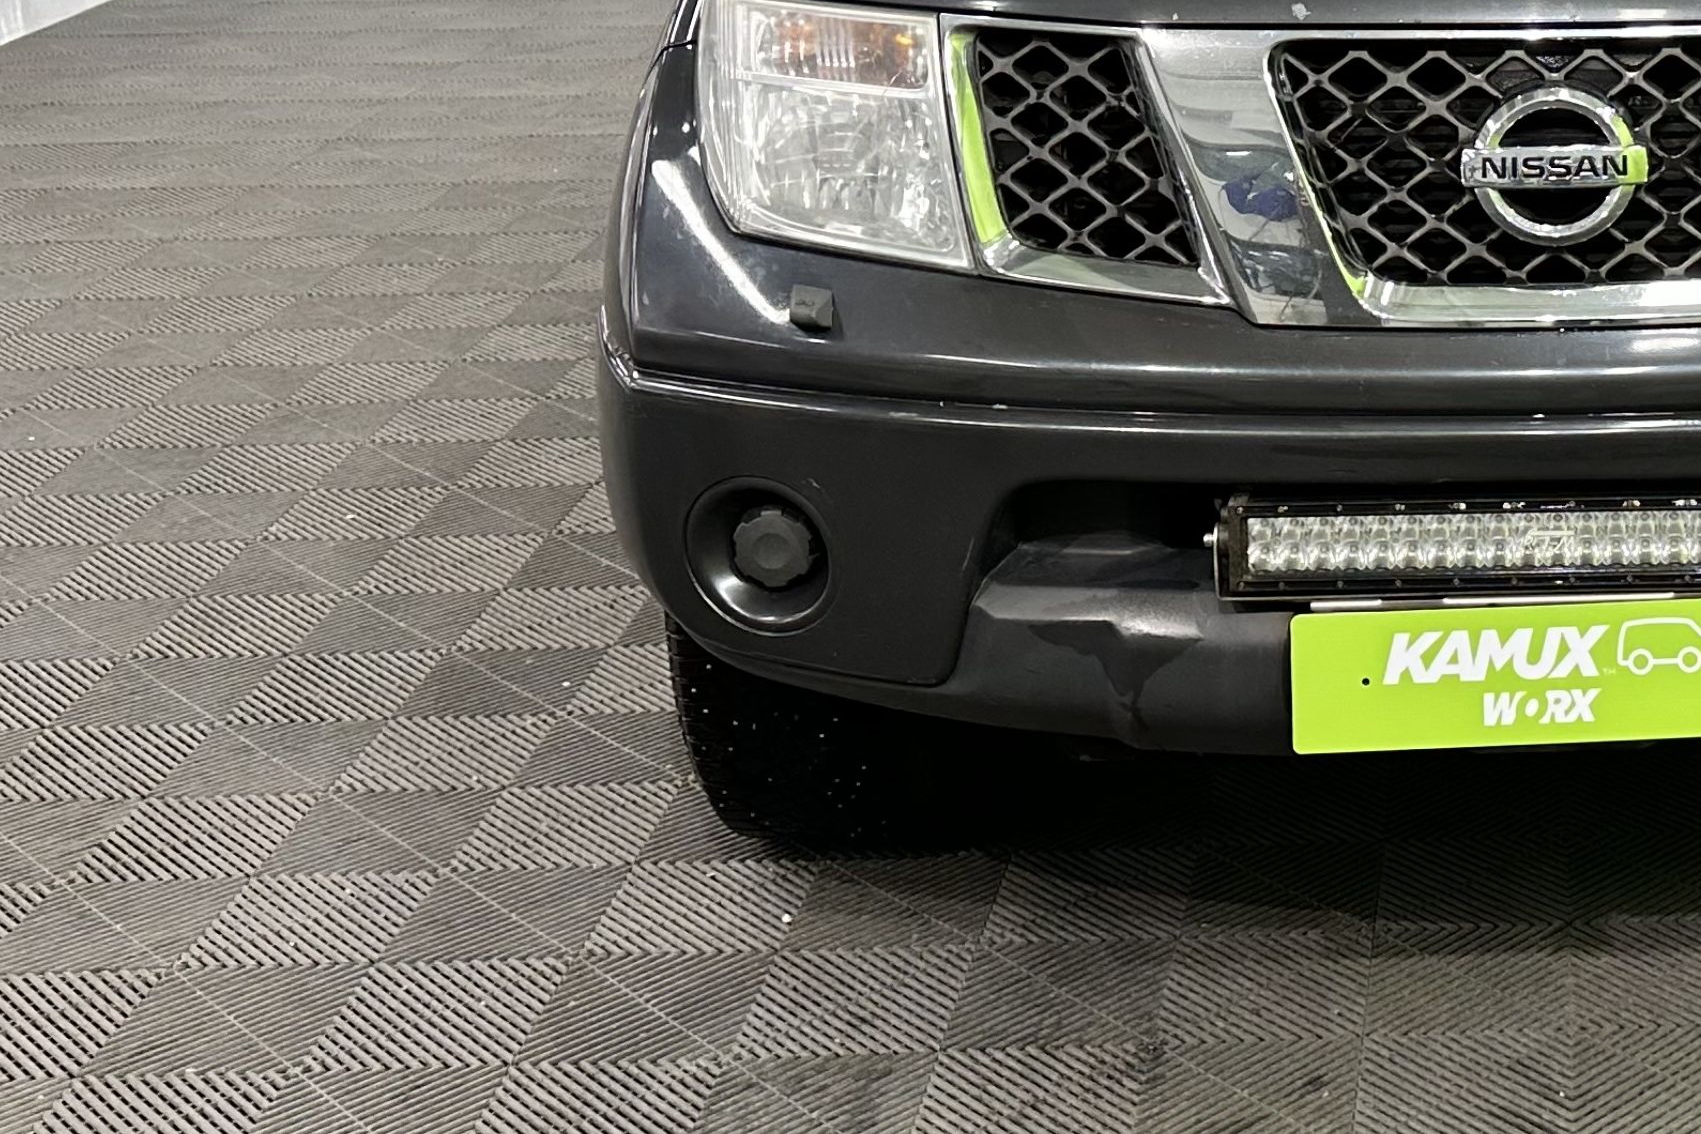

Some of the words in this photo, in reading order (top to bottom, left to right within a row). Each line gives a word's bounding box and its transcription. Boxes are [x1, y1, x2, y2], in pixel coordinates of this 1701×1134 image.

[1481, 155, 1627, 179] NISSAN
[1382, 625, 1610, 685] KAMUX
[1483, 688, 1602, 727] WORX
